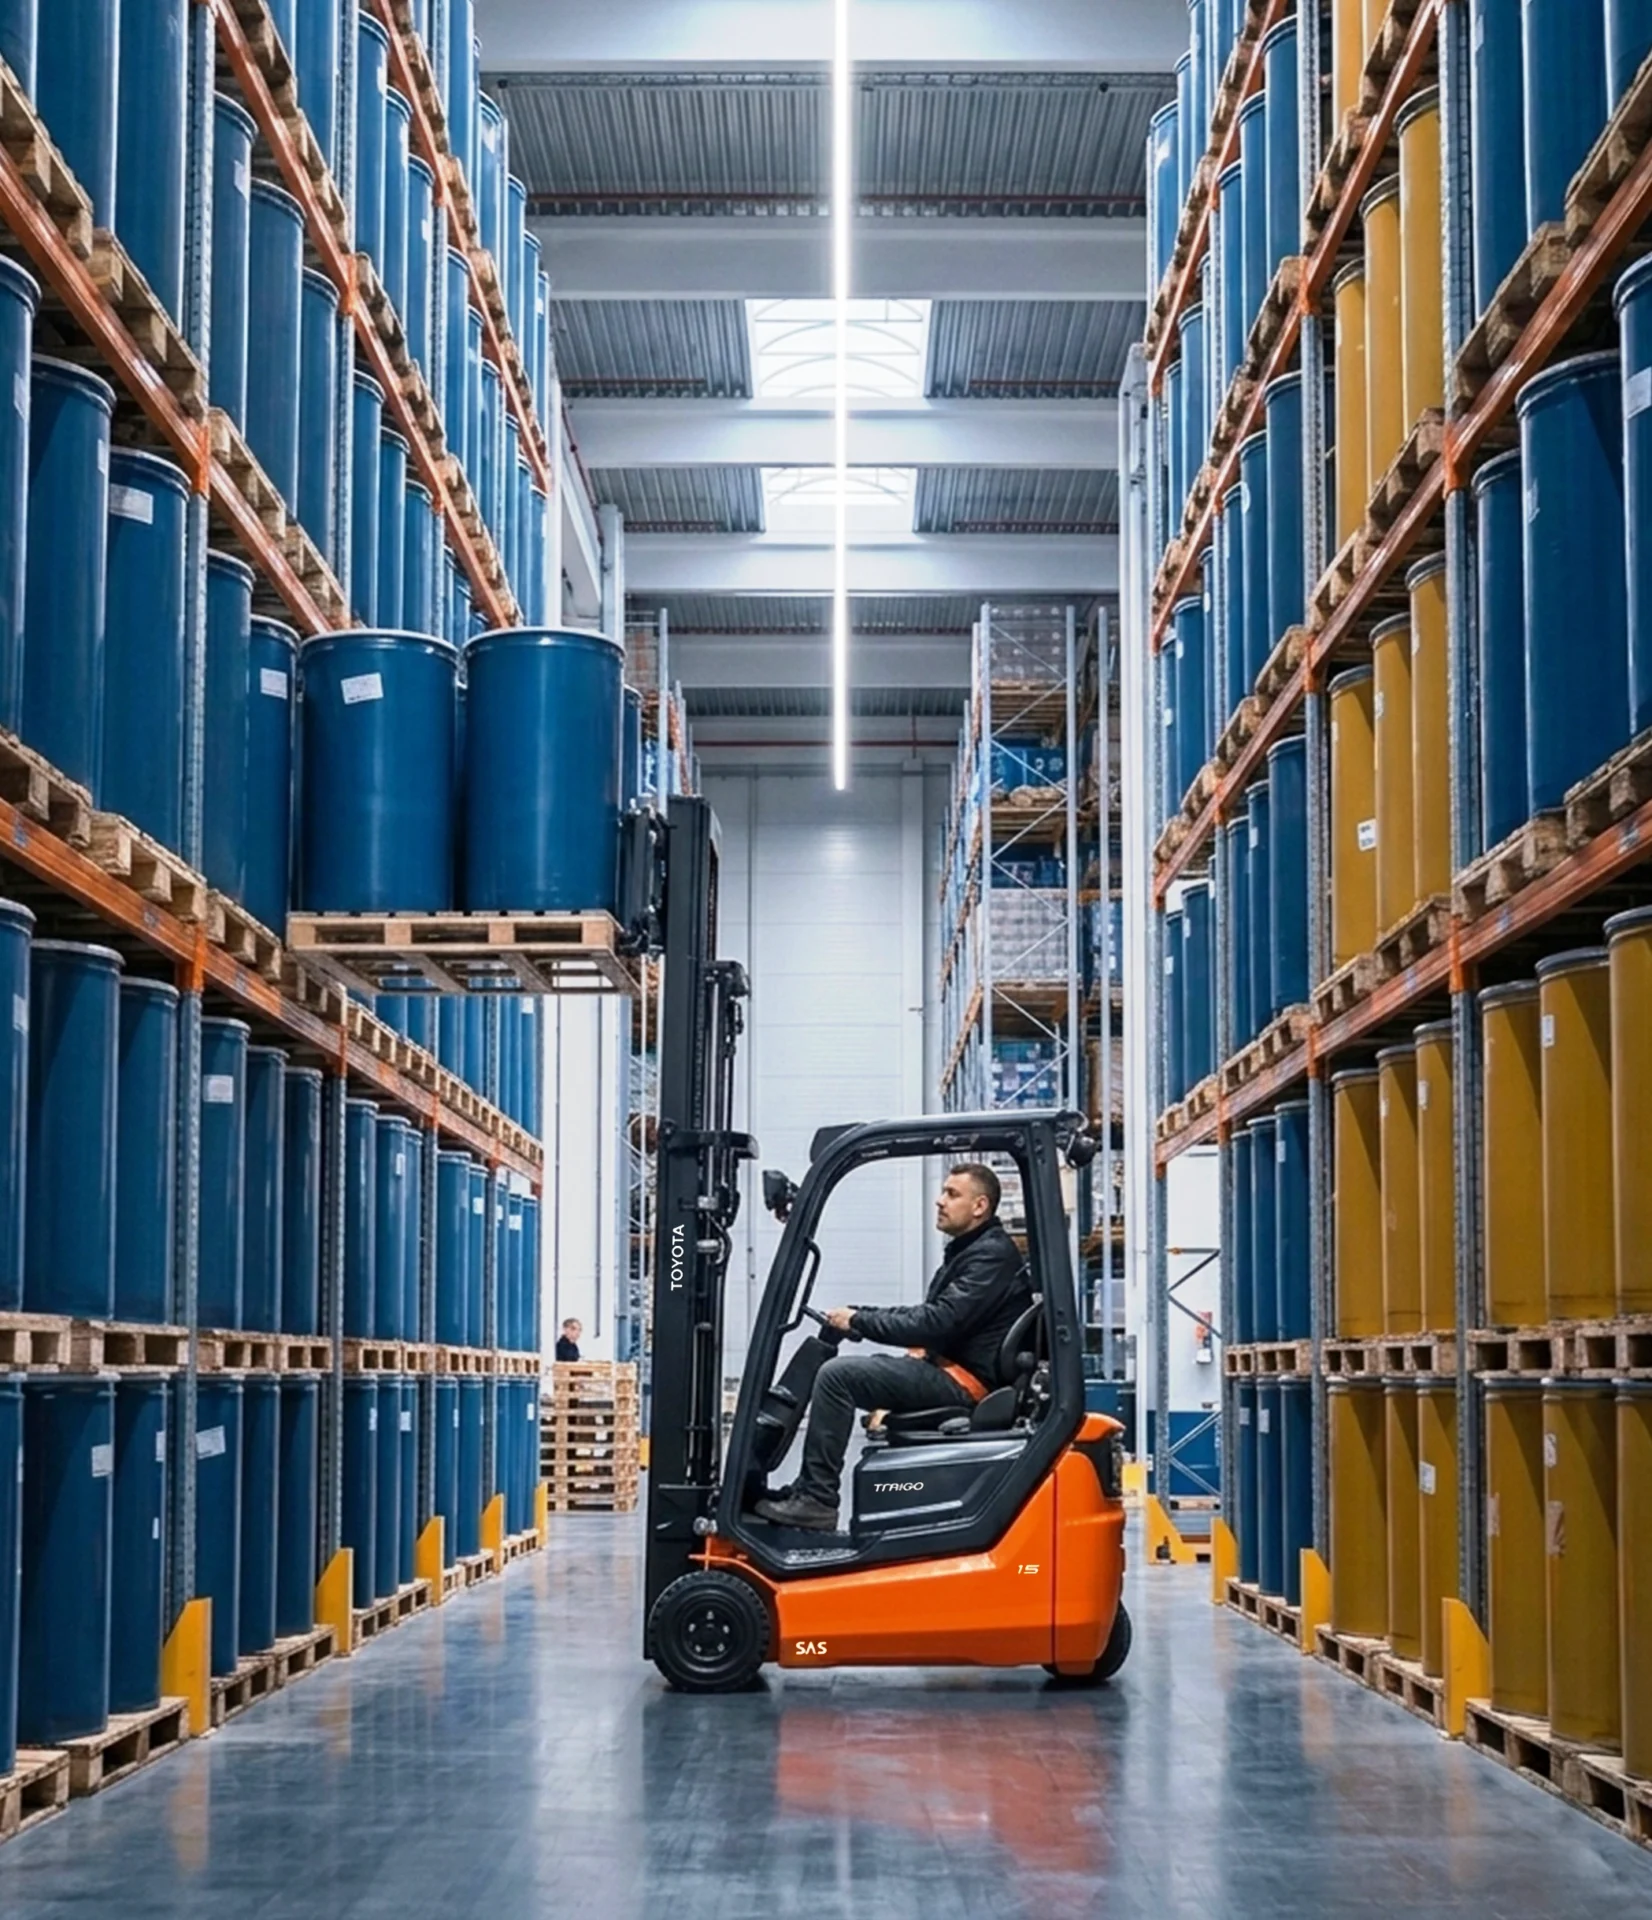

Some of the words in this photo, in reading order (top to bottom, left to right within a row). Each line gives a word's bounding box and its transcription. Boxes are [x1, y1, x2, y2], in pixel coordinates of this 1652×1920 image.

[670, 1224, 685, 1291] TOYOTA
[1017, 1564, 1040, 1574] 15
[795, 1641, 828, 1655] SAS
